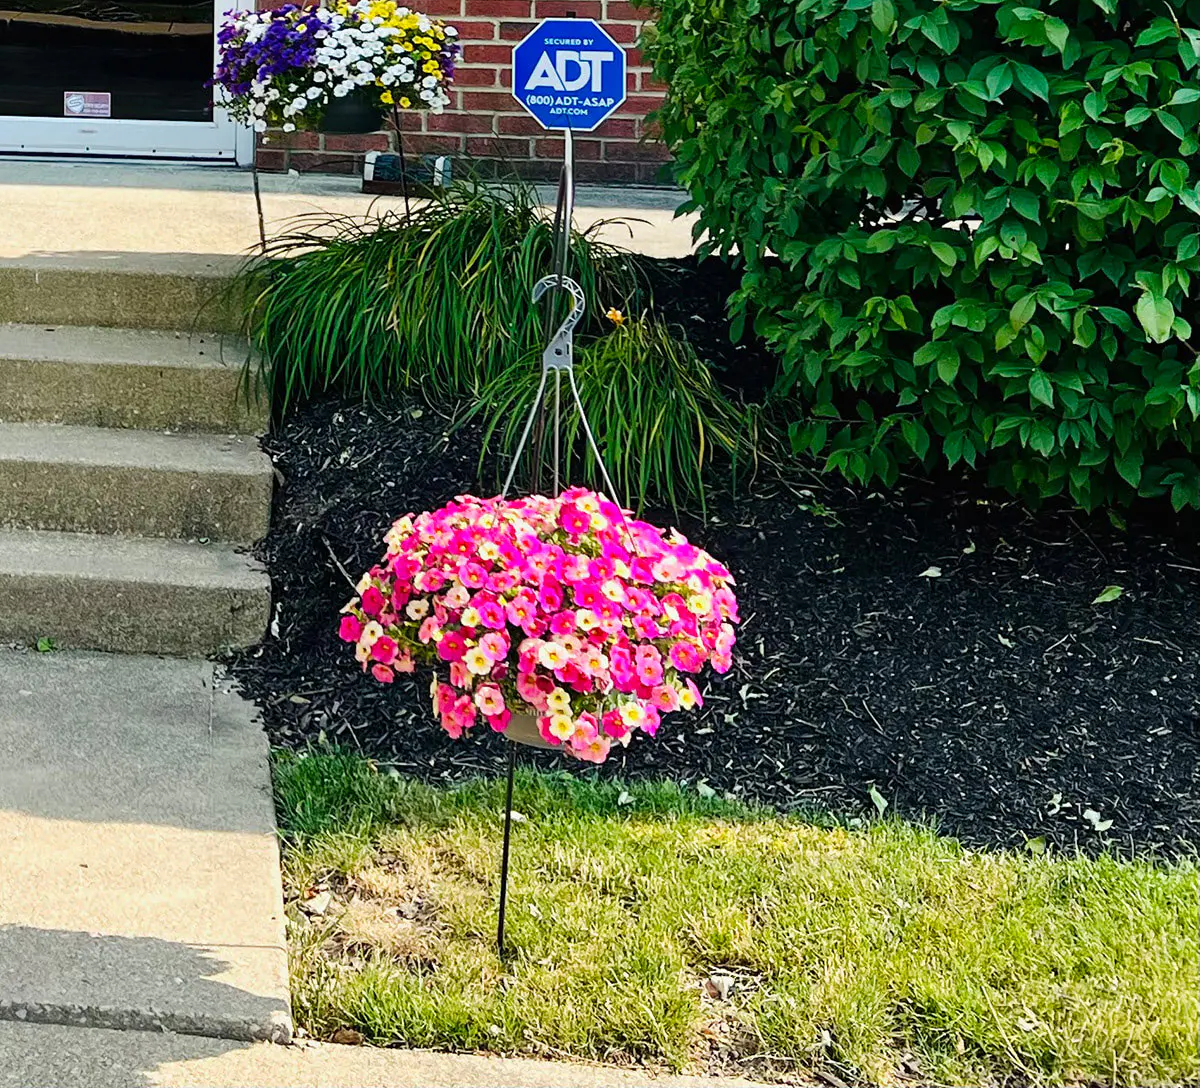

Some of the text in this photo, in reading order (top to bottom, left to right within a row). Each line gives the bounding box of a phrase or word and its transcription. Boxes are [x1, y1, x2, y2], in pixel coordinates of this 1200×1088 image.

[544, 38, 581, 46] SECURED
[524, 50, 614, 92] ADT
[526, 94, 615, 108] (800) ADT-ASAP
[549, 107, 588, 116] ADT.COM
